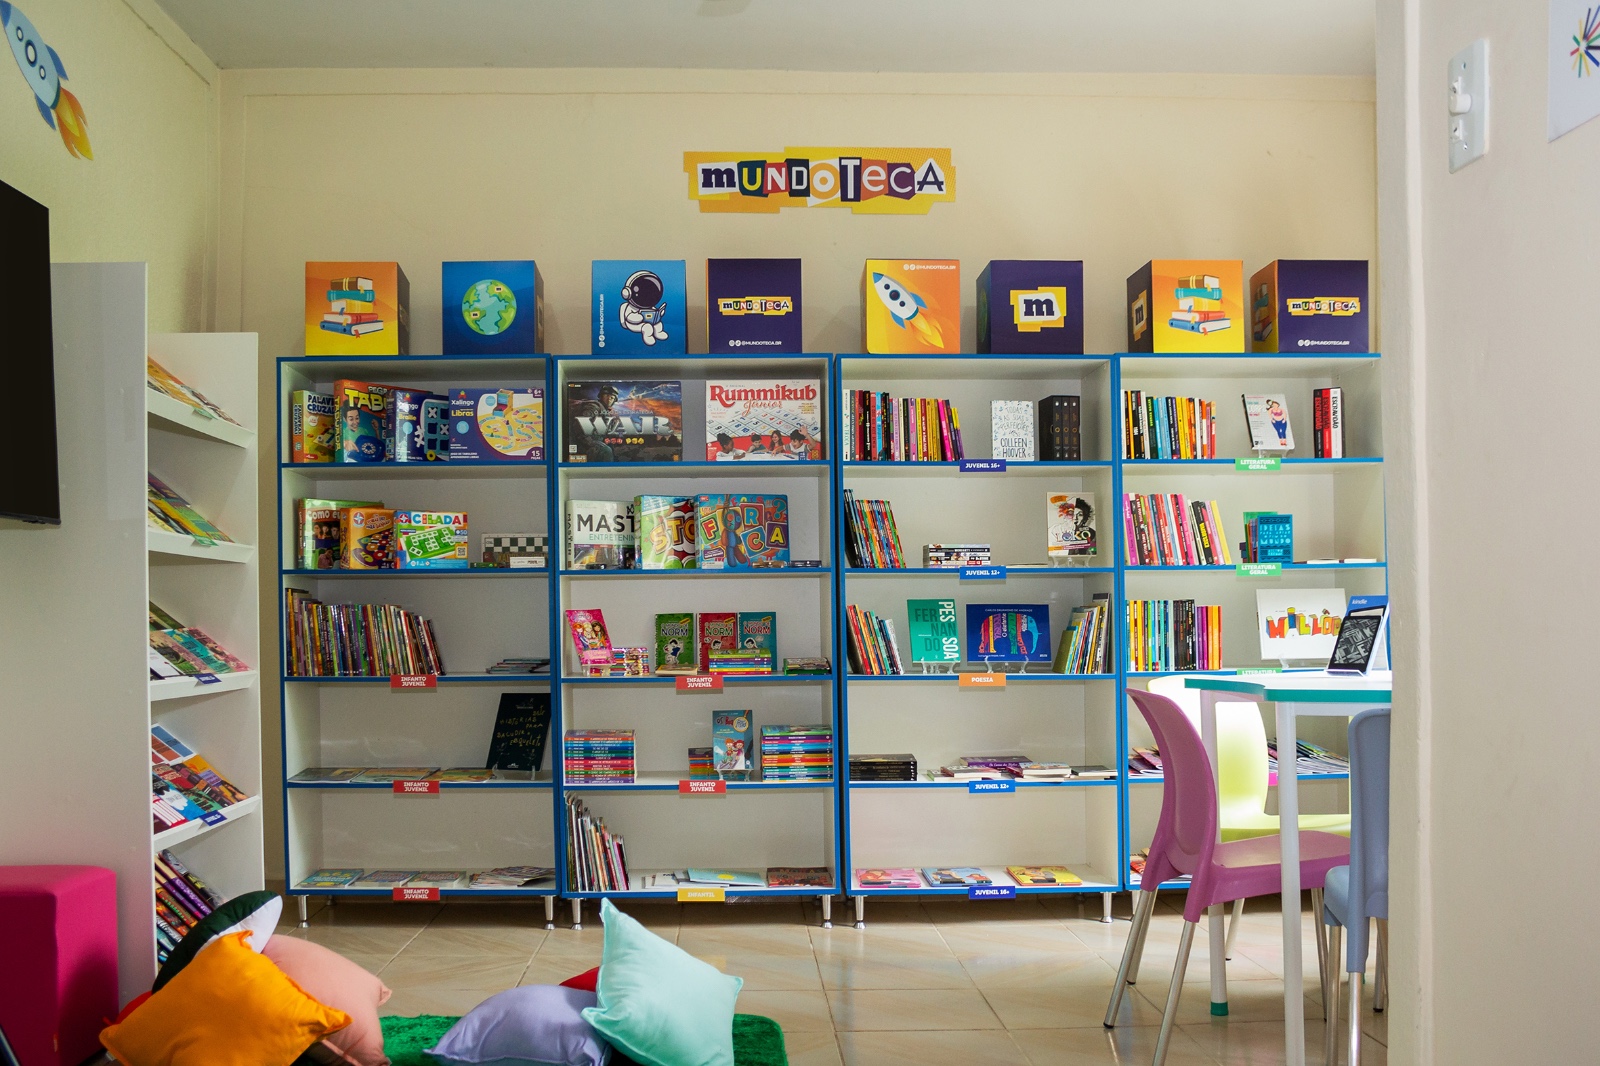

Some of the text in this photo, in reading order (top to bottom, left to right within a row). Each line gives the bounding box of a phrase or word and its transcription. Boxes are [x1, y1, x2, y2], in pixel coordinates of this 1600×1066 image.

[709, 384, 817, 408] Rummikub
[574, 416, 674, 435] WAR
[1001, 437, 1028, 448] COLLEEN
[1002, 448, 1027, 458] HOOVER
[412, 513, 462, 525] CILADA
[914, 608, 938, 622] FER
[661, 628, 688, 636] NORM
[705, 626, 733, 636] NORM
[743, 625, 771, 634] NORM
[931, 623, 957, 636] NAN
